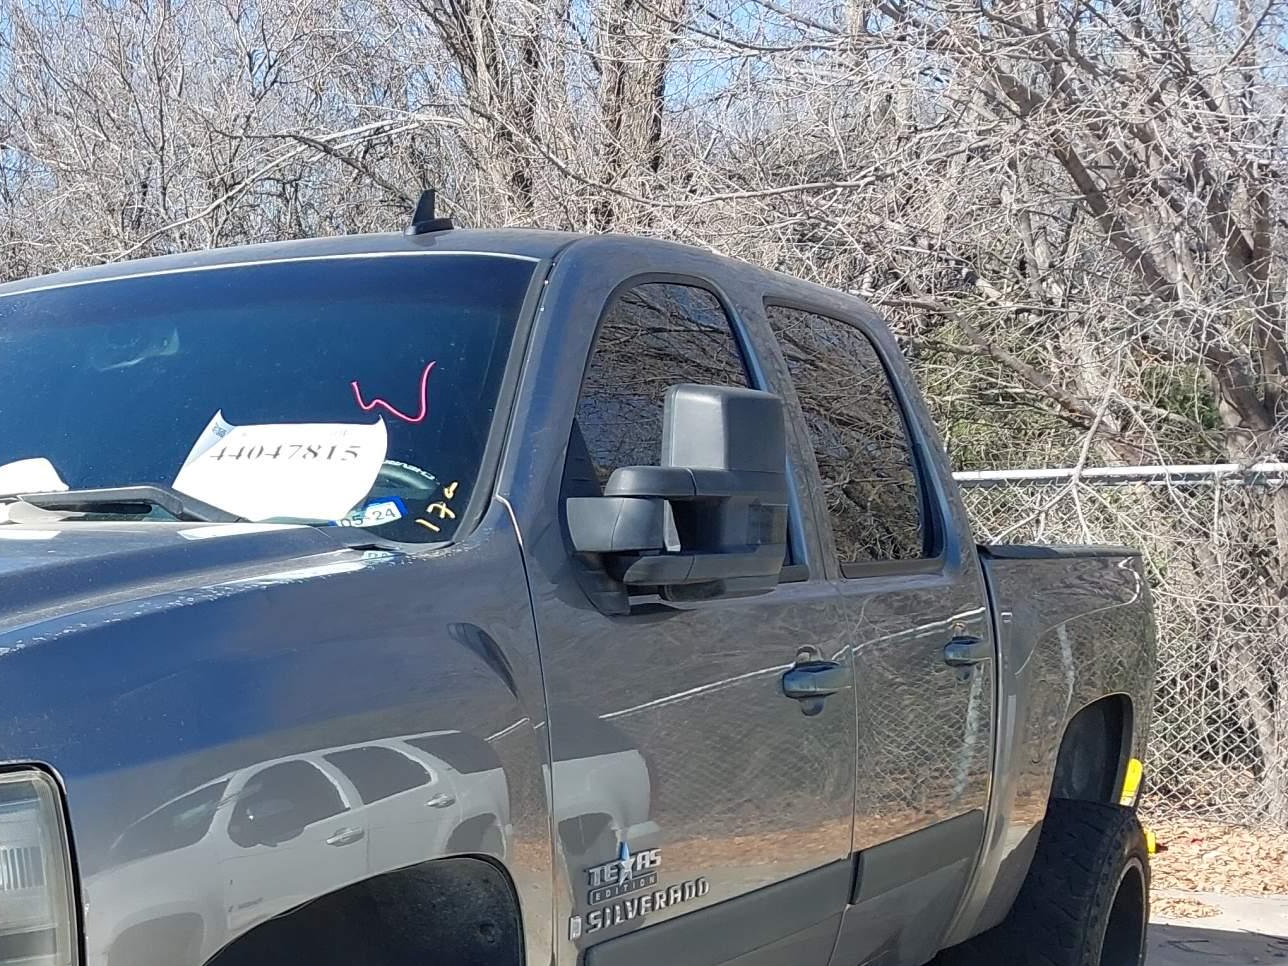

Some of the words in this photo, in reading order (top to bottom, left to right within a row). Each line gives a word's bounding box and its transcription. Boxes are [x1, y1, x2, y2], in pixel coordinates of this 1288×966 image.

[210, 444, 362, 461] 44047815
[588, 843, 662, 886] TEXAS
[586, 877, 710, 933] SILVERADO
[595, 875, 657, 901] EDITION
